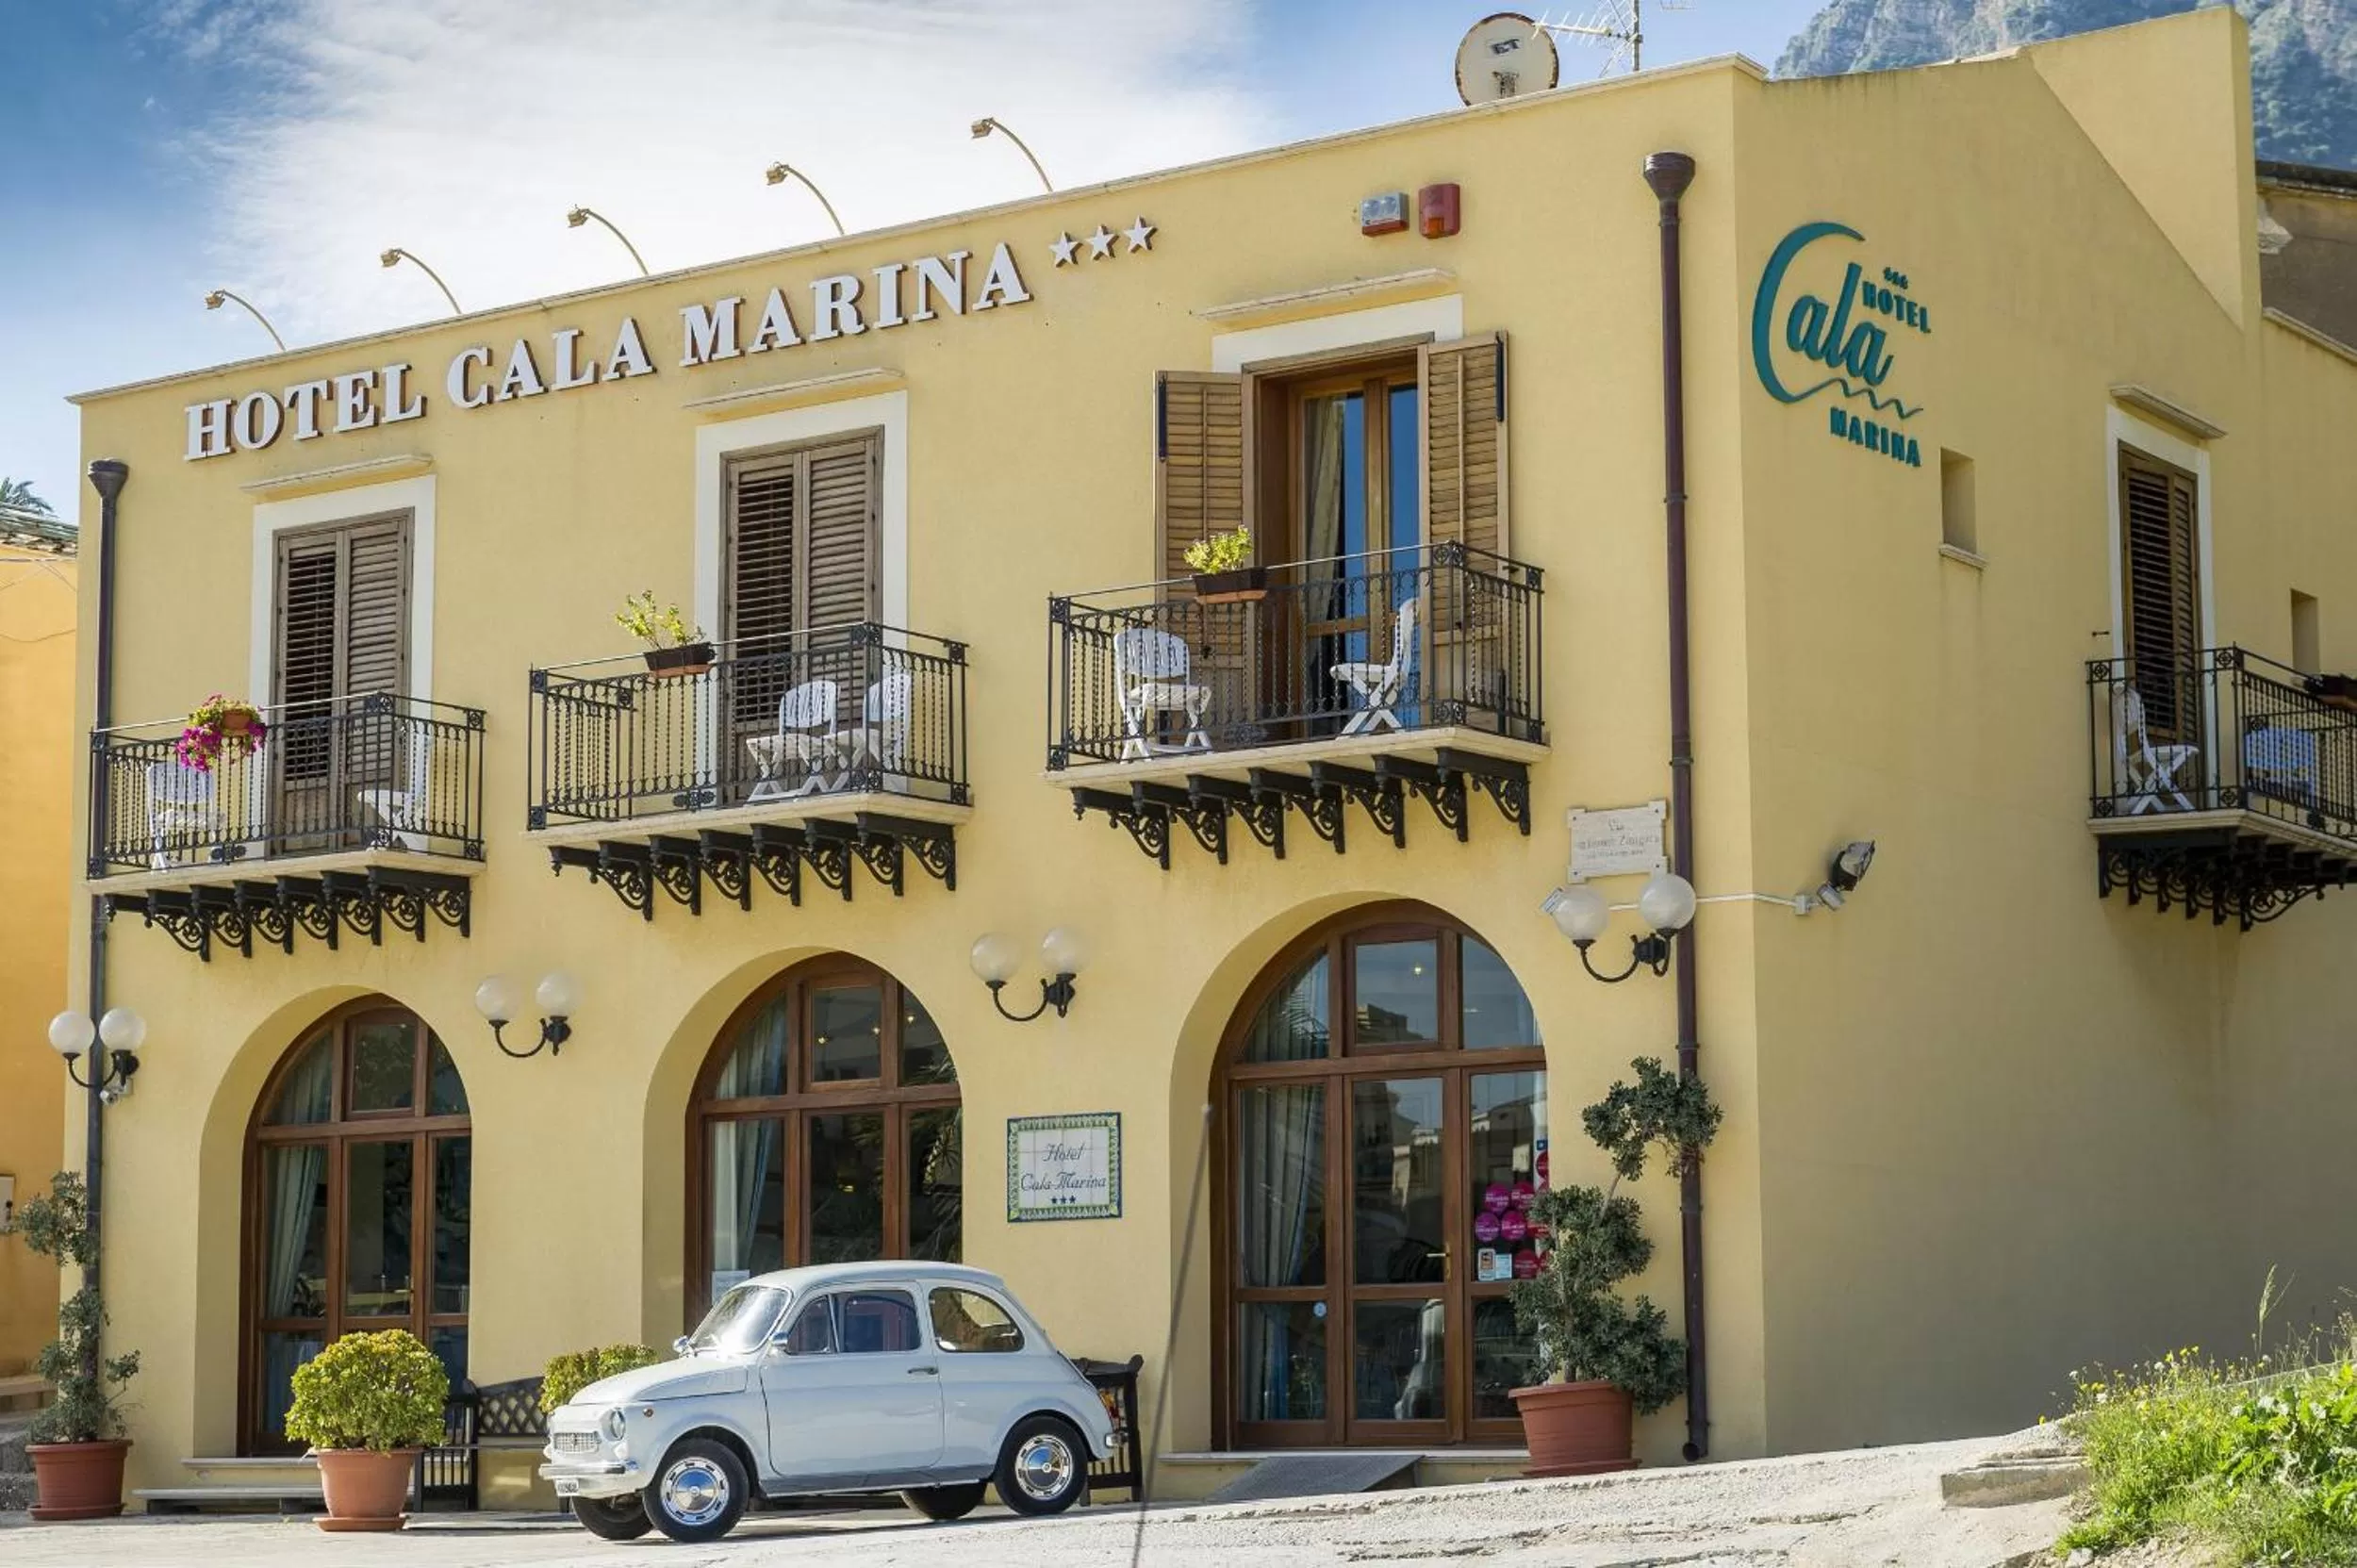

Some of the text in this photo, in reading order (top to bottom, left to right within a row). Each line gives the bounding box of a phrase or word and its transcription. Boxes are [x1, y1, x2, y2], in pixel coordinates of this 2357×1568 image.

[1752, 222, 1895, 404] Cala
[1861, 280, 1932, 334] HOTEL
[184, 241, 1034, 461] HOTEL CALA MARINA
[1830, 406, 1920, 468] MARINA
[1042, 1142, 1085, 1162] Hotel
